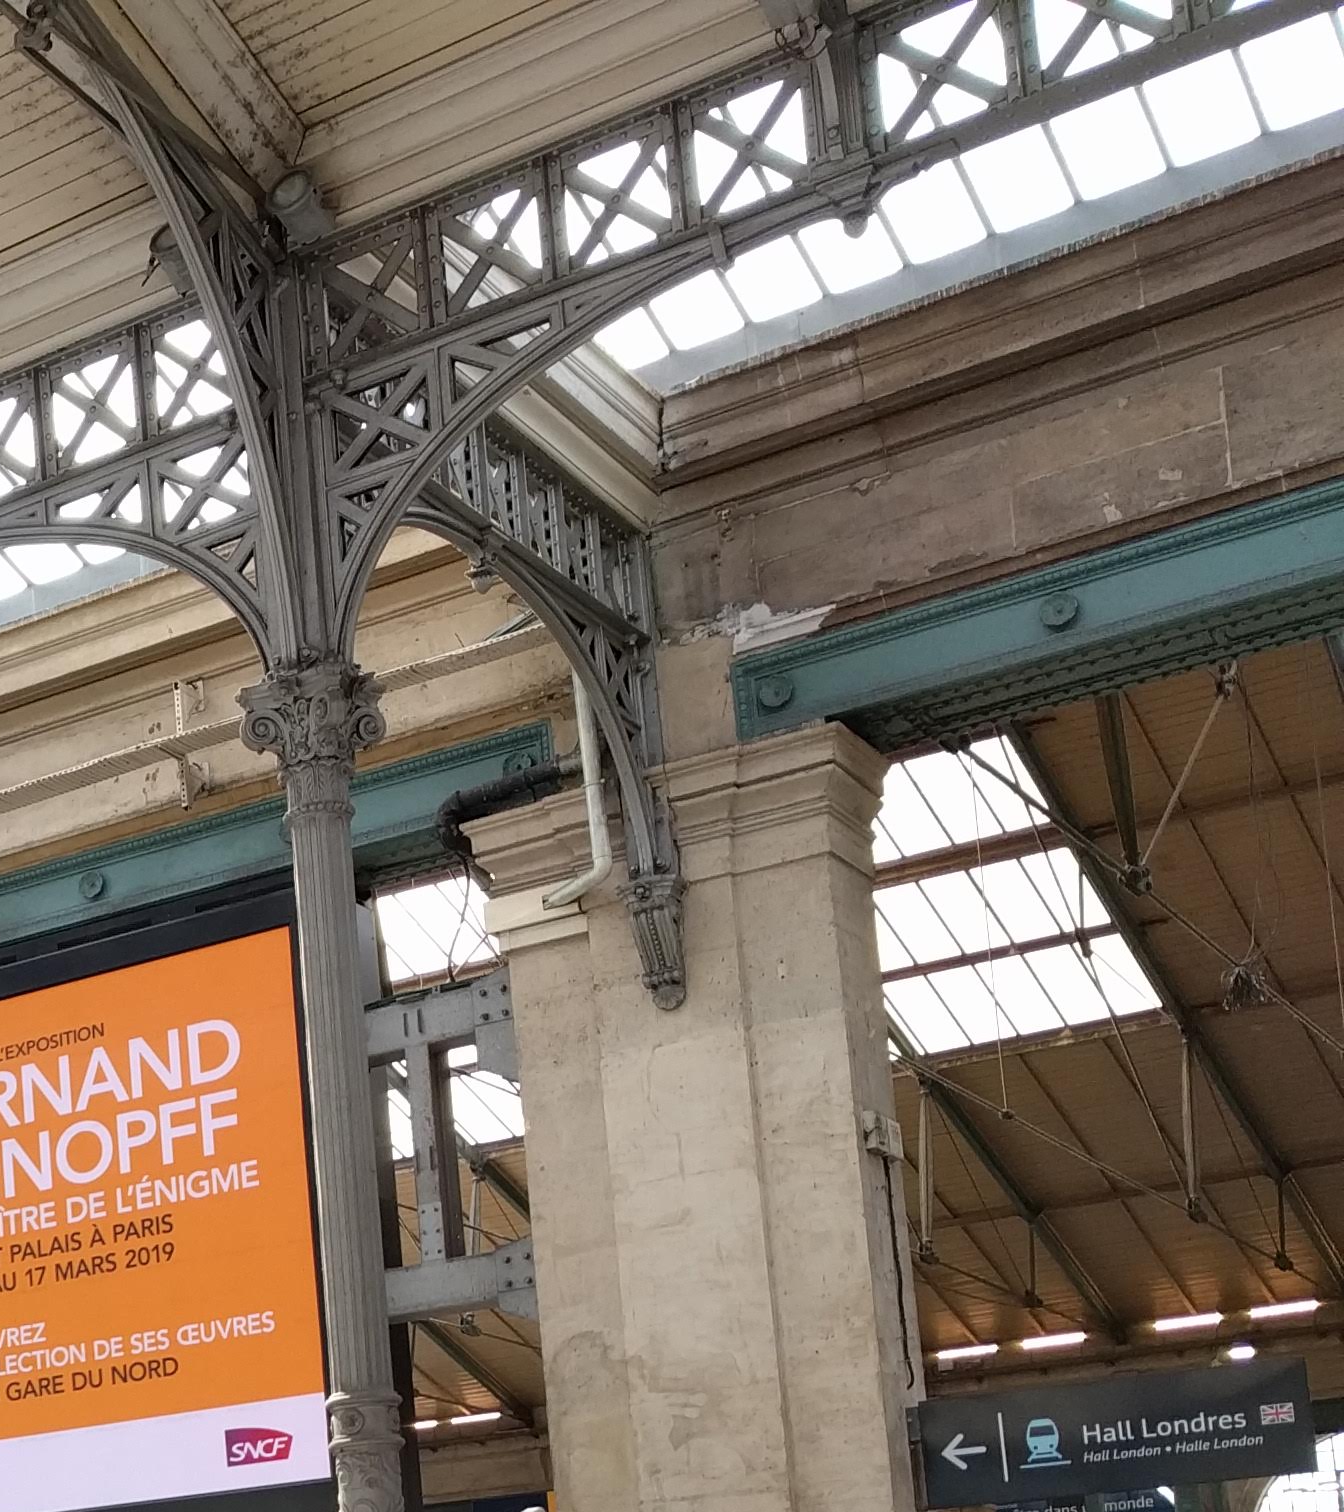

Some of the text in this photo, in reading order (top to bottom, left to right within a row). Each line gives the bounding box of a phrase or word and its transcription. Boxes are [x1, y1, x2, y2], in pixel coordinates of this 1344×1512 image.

[65, 1191, 108, 1223] DE
[115, 1159, 260, 1214] L'ÉNIGME
[10, 1231, 82, 1263] PALAIS
[90, 1224, 106, 1248] À
[113, 1214, 174, 1244] PARIS
[25, 1266, 47, 1288] 17
[54, 1252, 117, 1282] MARS
[125, 1241, 175, 1269] 2019
[93, 1337, 125, 1361] DE
[130, 1328, 170, 1355] SES
[176, 1311, 275, 1346] ŒUVRES
[6, 1375, 66, 1401] GARE
[72, 1369, 103, 1391] DU
[111, 1357, 179, 1385] NORD
[229, 1437, 288, 1462] SNCF
[1082, 1411, 1247, 1445] Hall Londres
[1083, 1435, 1264, 1463] Hall London Halle London
[1104, 1496, 1154, 1512] monde
